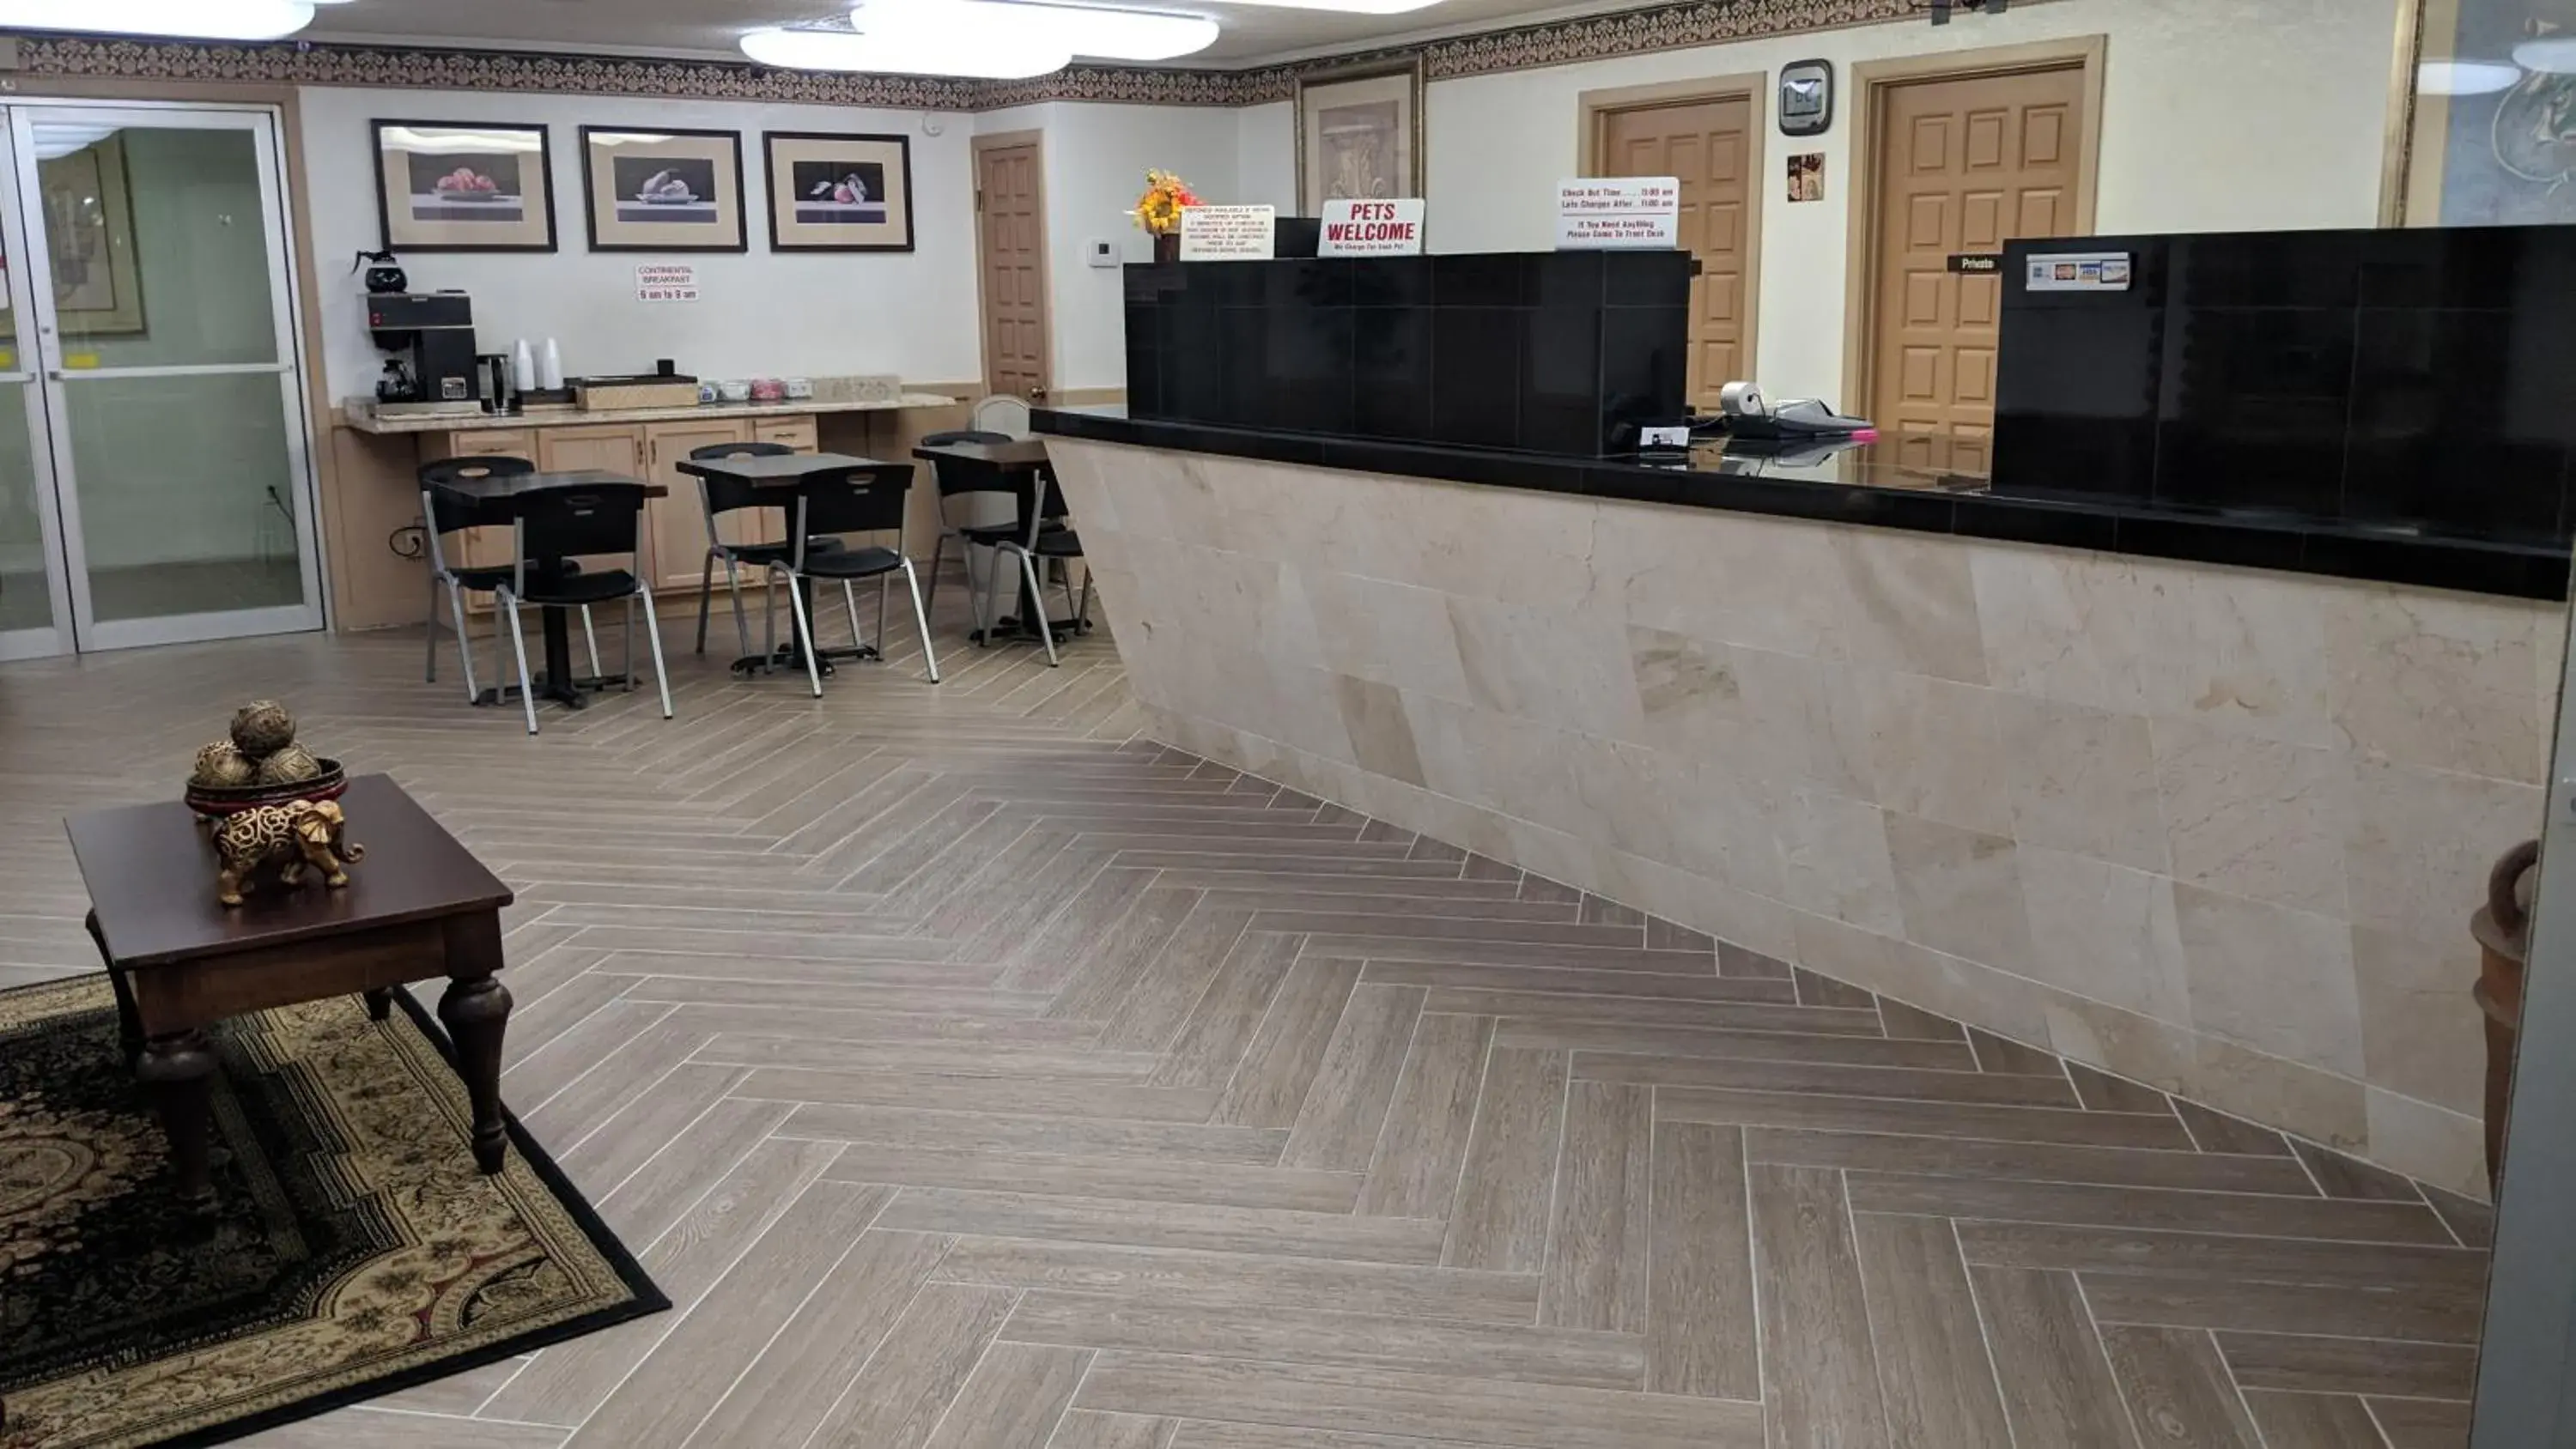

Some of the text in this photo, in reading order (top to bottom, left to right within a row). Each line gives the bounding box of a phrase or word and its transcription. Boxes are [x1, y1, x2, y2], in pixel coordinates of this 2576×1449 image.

[1588, 188, 1600, 197] Out
[1580, 200, 1610, 209] Charges
[1351, 203, 1395, 221] PETS
[1622, 220, 1655, 229] Anything
[1327, 222, 1415, 241] WELCOME
[1646, 229, 1664, 238] Desk
[1962, 258, 1995, 269] Private
[643, 275, 690, 283] BREAKFAST
